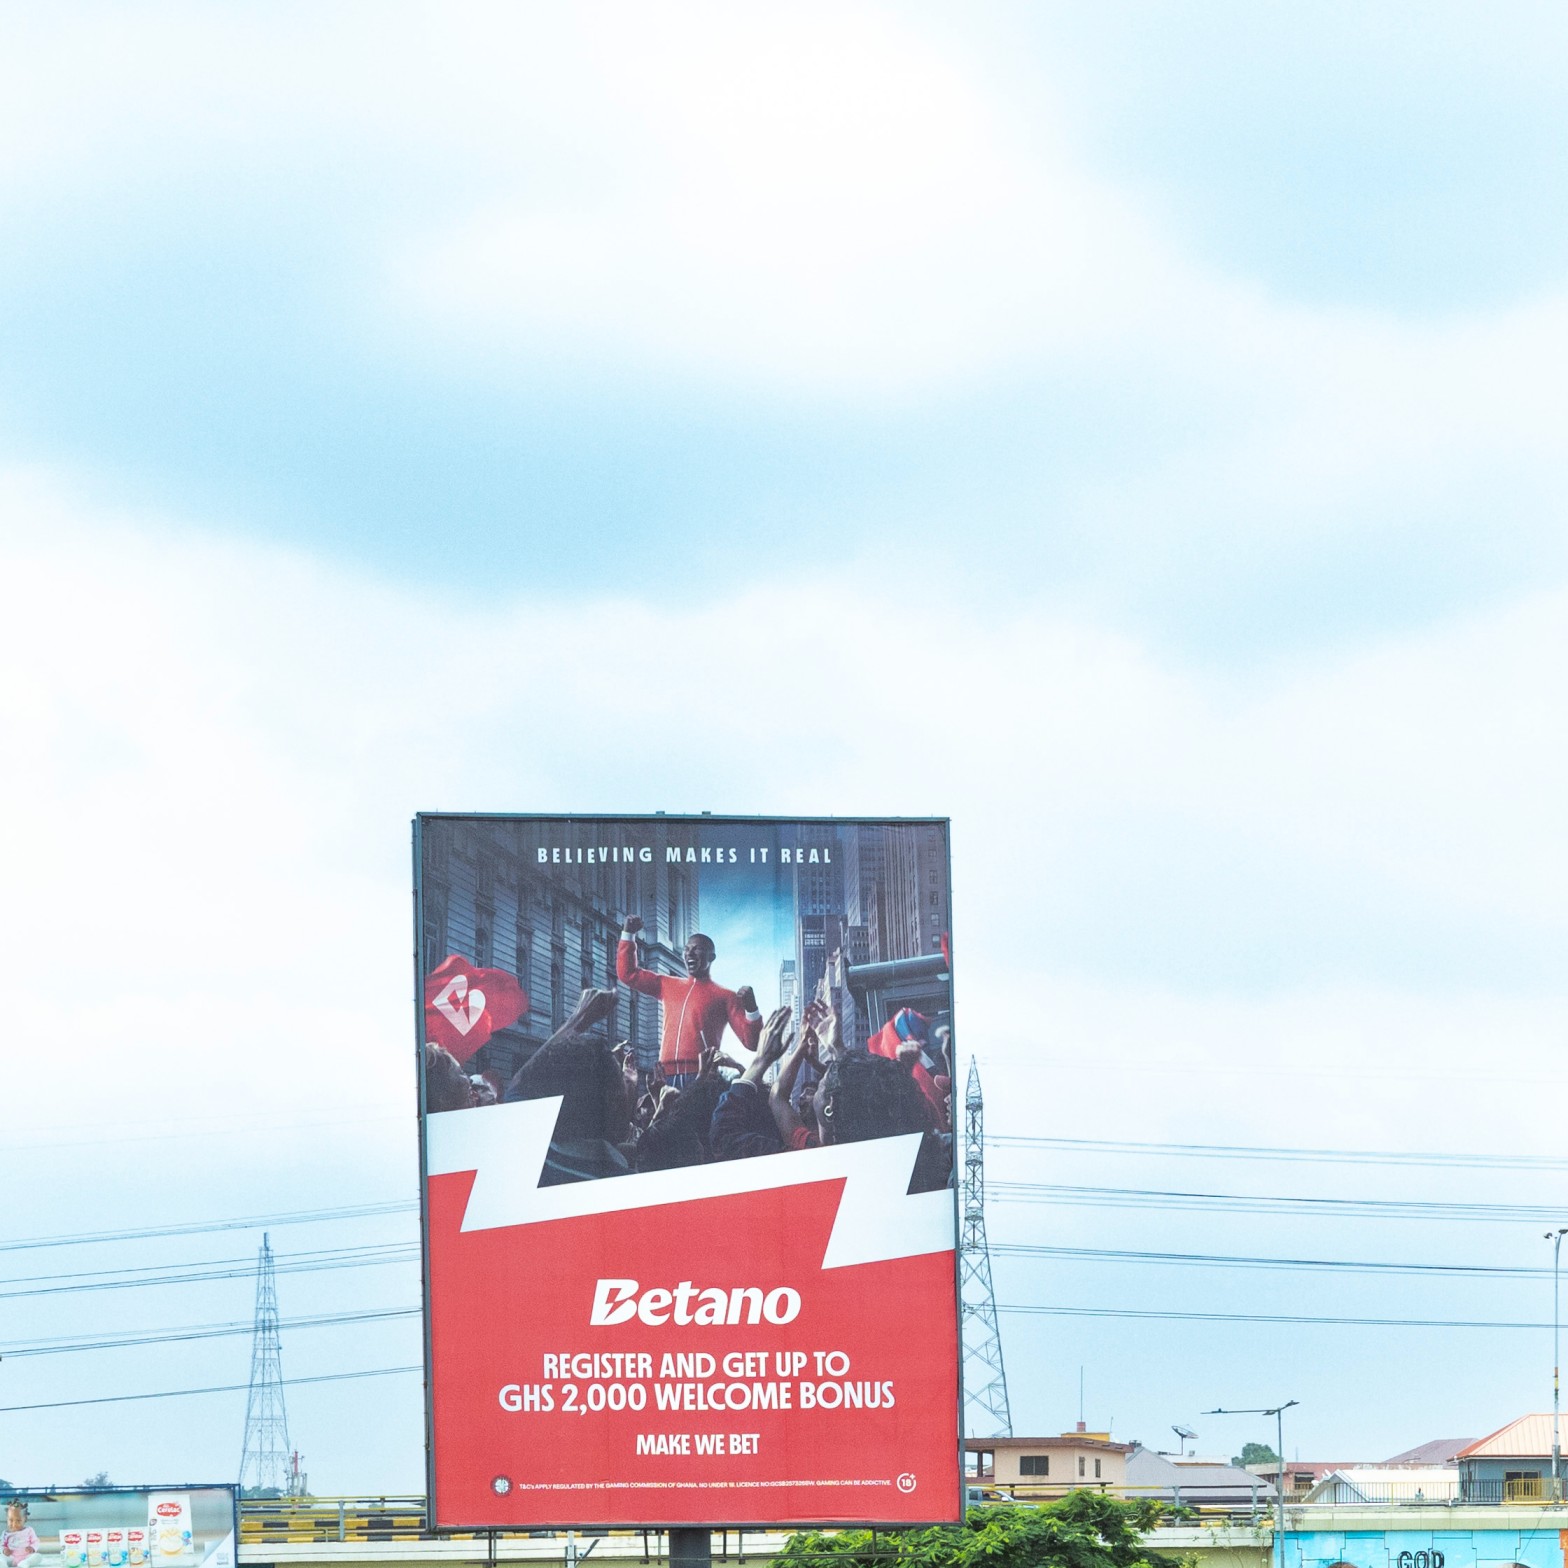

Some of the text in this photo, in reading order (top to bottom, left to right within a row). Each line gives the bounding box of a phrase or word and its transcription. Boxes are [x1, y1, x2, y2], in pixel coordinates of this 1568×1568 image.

[537, 847, 831, 864] BELIEVING MAKES IT REAL
[590, 1279, 801, 1326] Betano
[543, 1350, 850, 1379] REGISTER AND GET UP TO
[498, 1380, 895, 1416] GHS 2,000 WELCOME BONUS
[636, 1434, 760, 1455] MAKE WE BET
